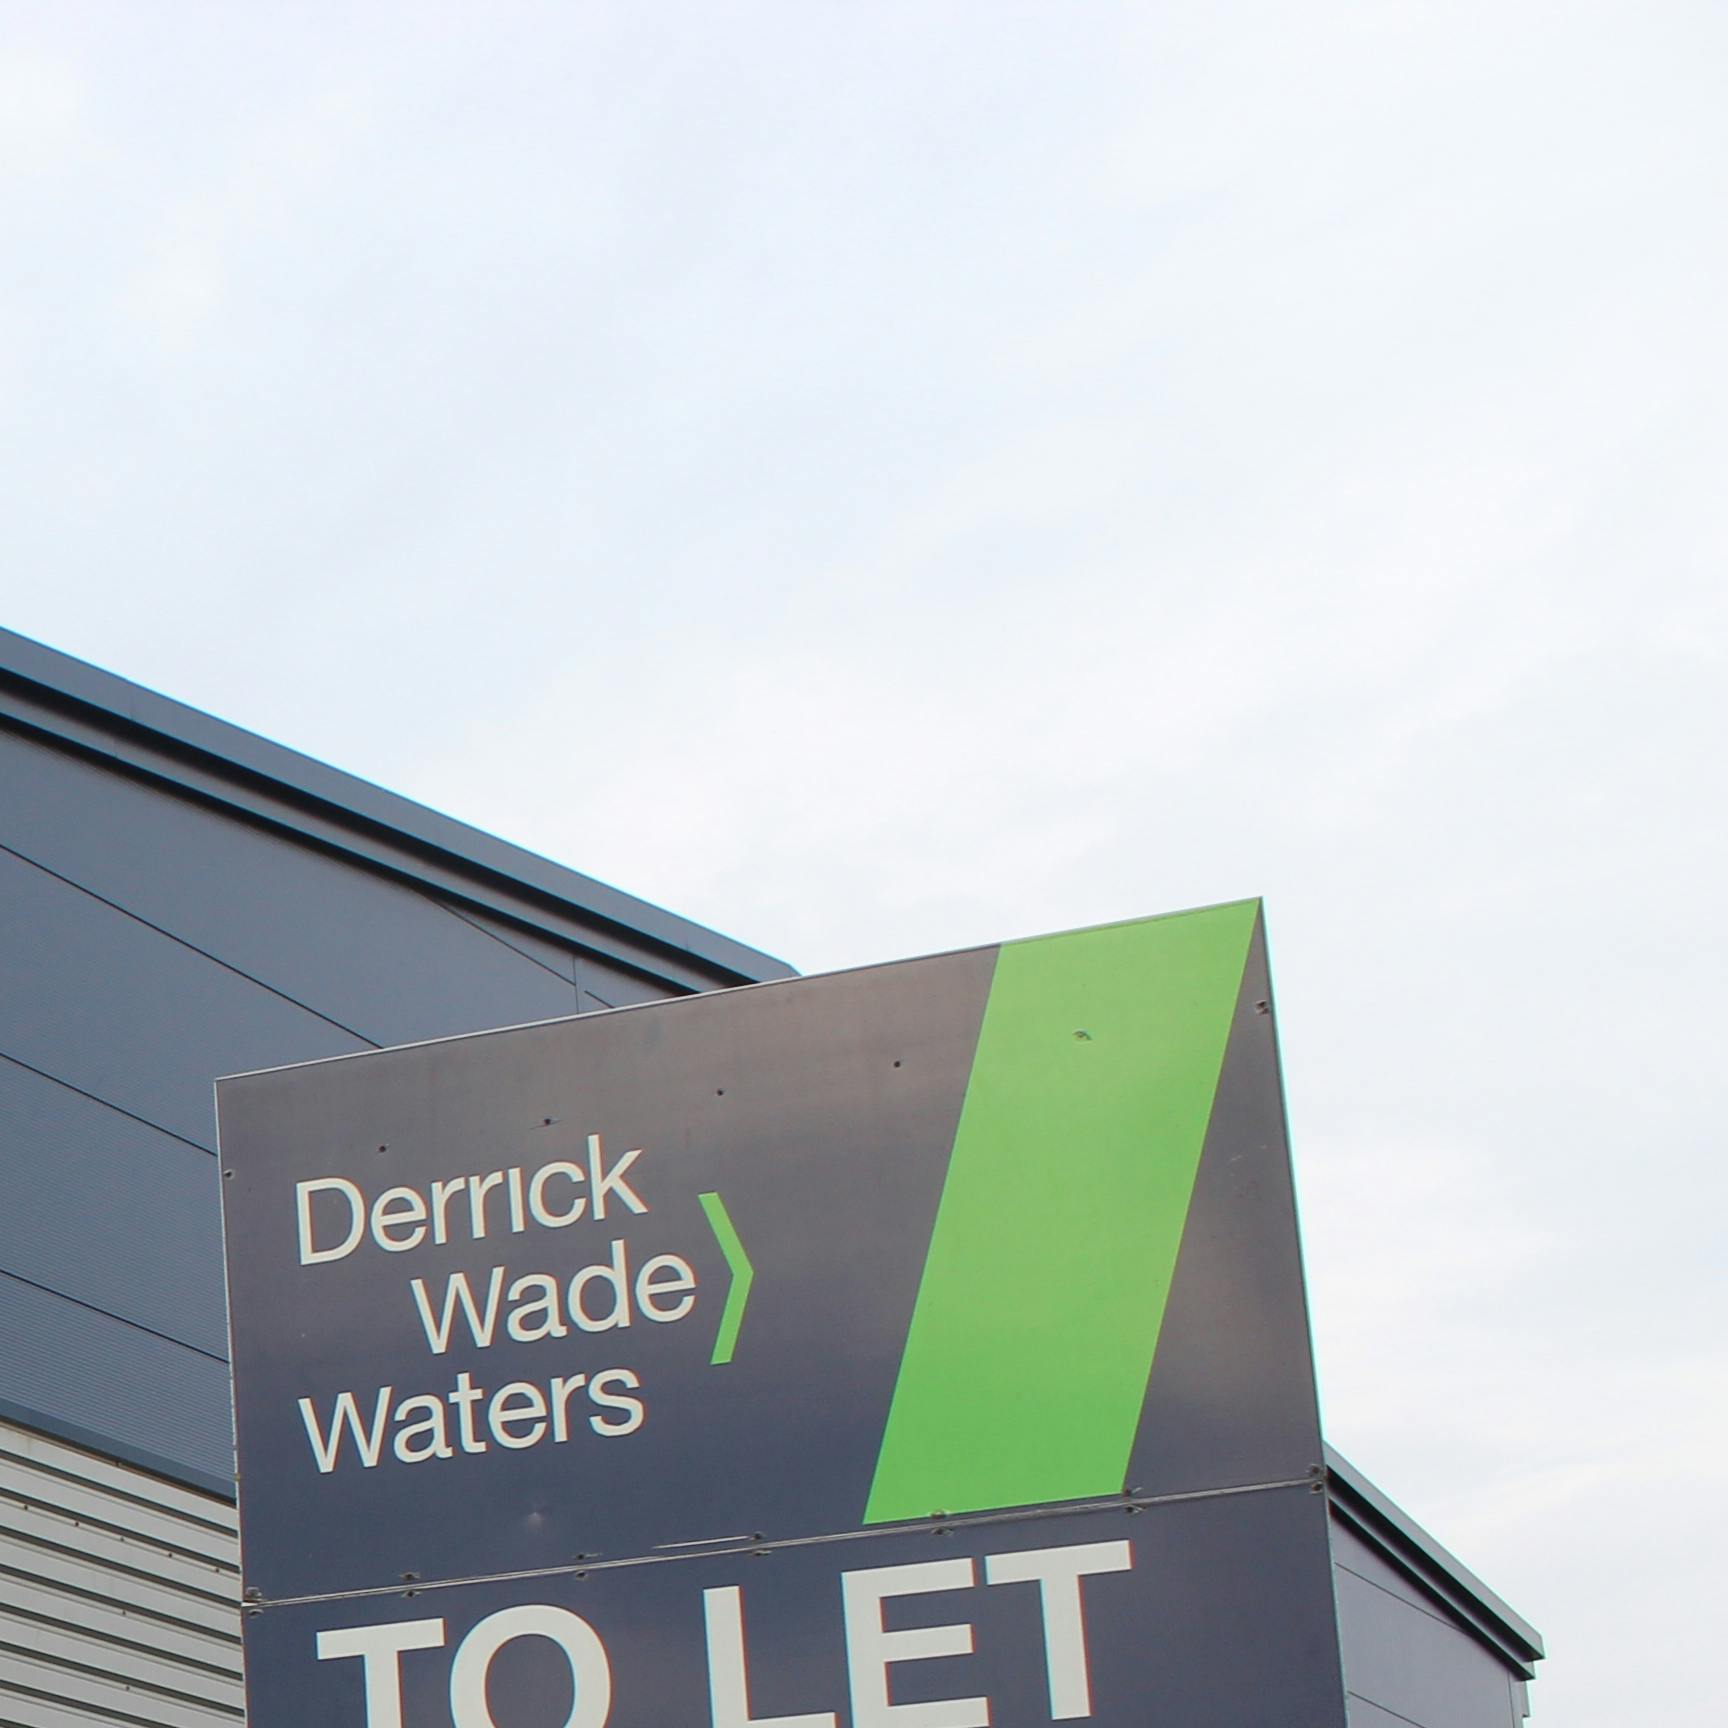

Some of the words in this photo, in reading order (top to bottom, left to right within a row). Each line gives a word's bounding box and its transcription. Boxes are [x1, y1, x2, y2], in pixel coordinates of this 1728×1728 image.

[295, 1135, 649, 1266] Derrick
[410, 1239, 697, 1355] Wade
[298, 1368, 645, 1474] Waters
